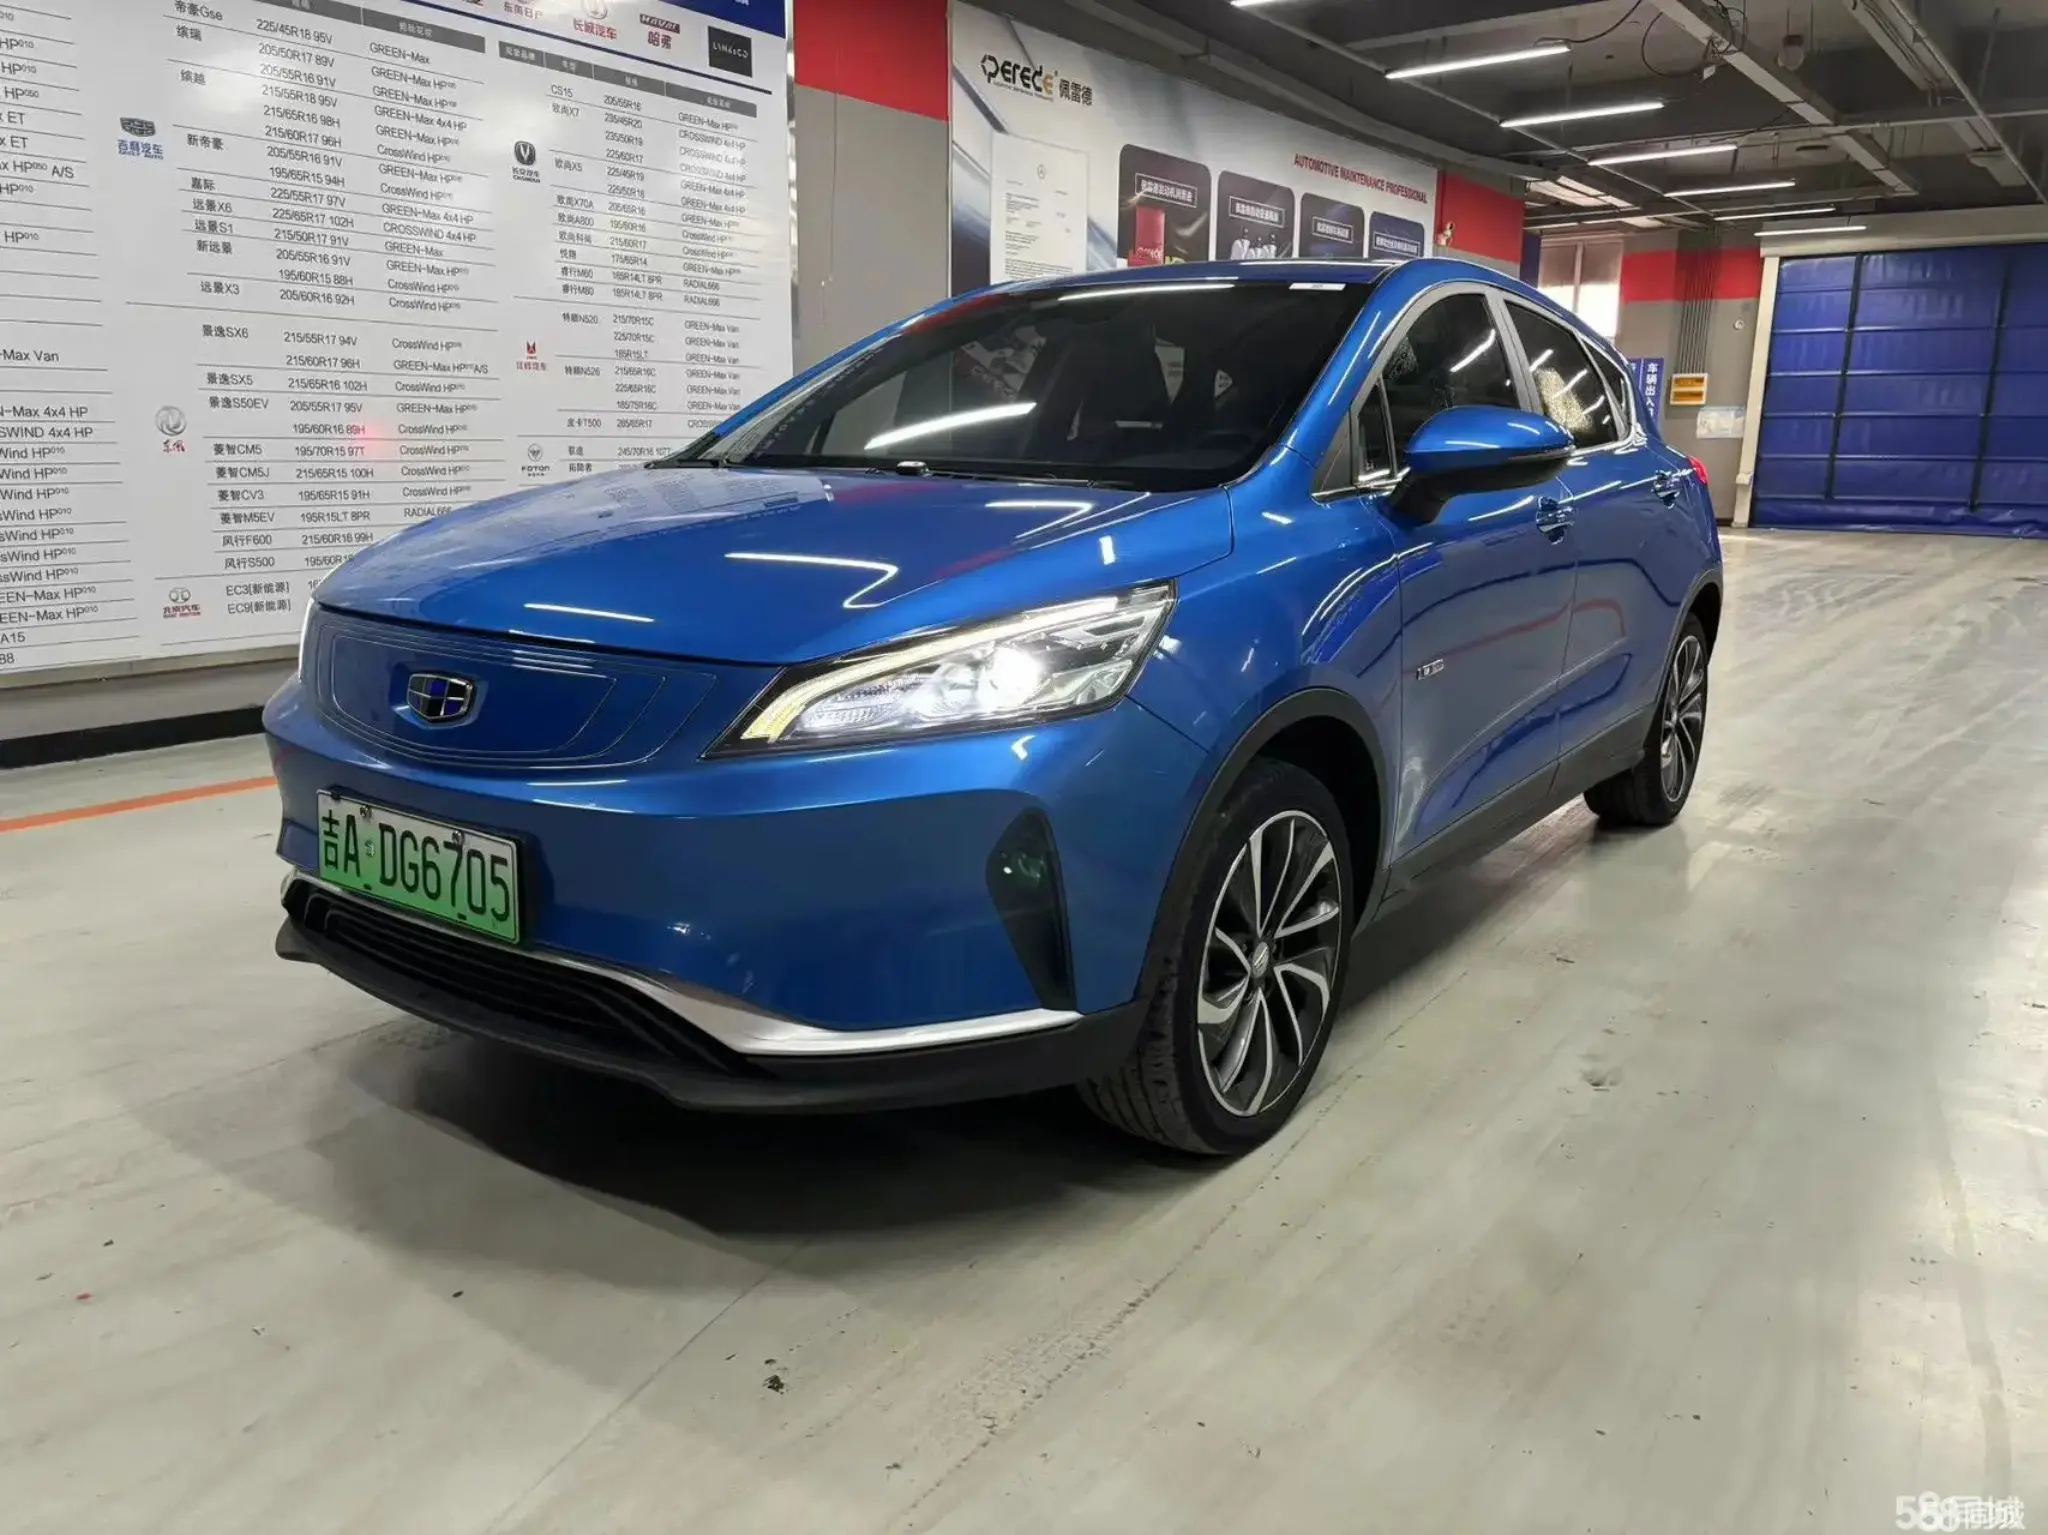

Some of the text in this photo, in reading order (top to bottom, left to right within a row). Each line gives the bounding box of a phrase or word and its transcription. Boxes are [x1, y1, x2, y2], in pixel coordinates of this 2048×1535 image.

[256, 19, 311, 41] 225/45R18
[648, 32, 672, 50] 哈弗
[258, 43, 313, 62] 205/50R17
[260, 64, 315, 83] 205/55R16
[262, 84, 317, 104] 215/55R18
[551, 84, 573, 98] CS15
[8, 111, 25, 125] ET
[264, 105, 318, 124] 215/65R16
[265, 126, 319, 143] 215/60R17
[10, 135, 28, 149] ET
[267, 146, 321, 164] 205/55R16
[52, 165, 75, 179] A/S
[270, 167, 323, 184] 195/65R15
[1294, 153, 1428, 205] AUTOMOTIVE MAINTENANCE PROFESSIONAL
[271, 187, 324, 204] 225/55R17
[272, 207, 325, 224] 225/65R17
[274, 228, 327, 245] 215/50R17
[276, 248, 330, 265] 205/55R16
[279, 269, 331, 284] 195/60R15
[280, 289, 332, 304] 205/60R16
[284, 331, 336, 345] 215/55R17
[33, 350, 60, 362] Van
[286, 355, 338, 367] 215/60R17
[288, 378, 340, 390] 215/65R16
[43, 406, 66, 417] 4x4
[69, 407, 88, 418] HP
[290, 400, 342, 412] 205/55R17
[48, 427, 71, 438] 4x4
[74, 427, 93, 438] HP
[293, 423, 344, 435] 195/60R16
[295, 446, 346, 457] 195/70R15
[296, 467, 347, 479] 215/65R15
[0, 488, 33, 500] Wind
[298, 490, 349, 501] 195/65R15
[301, 512, 348, 523] 195R15LT
[302, 534, 353, 545] 215/60R16
